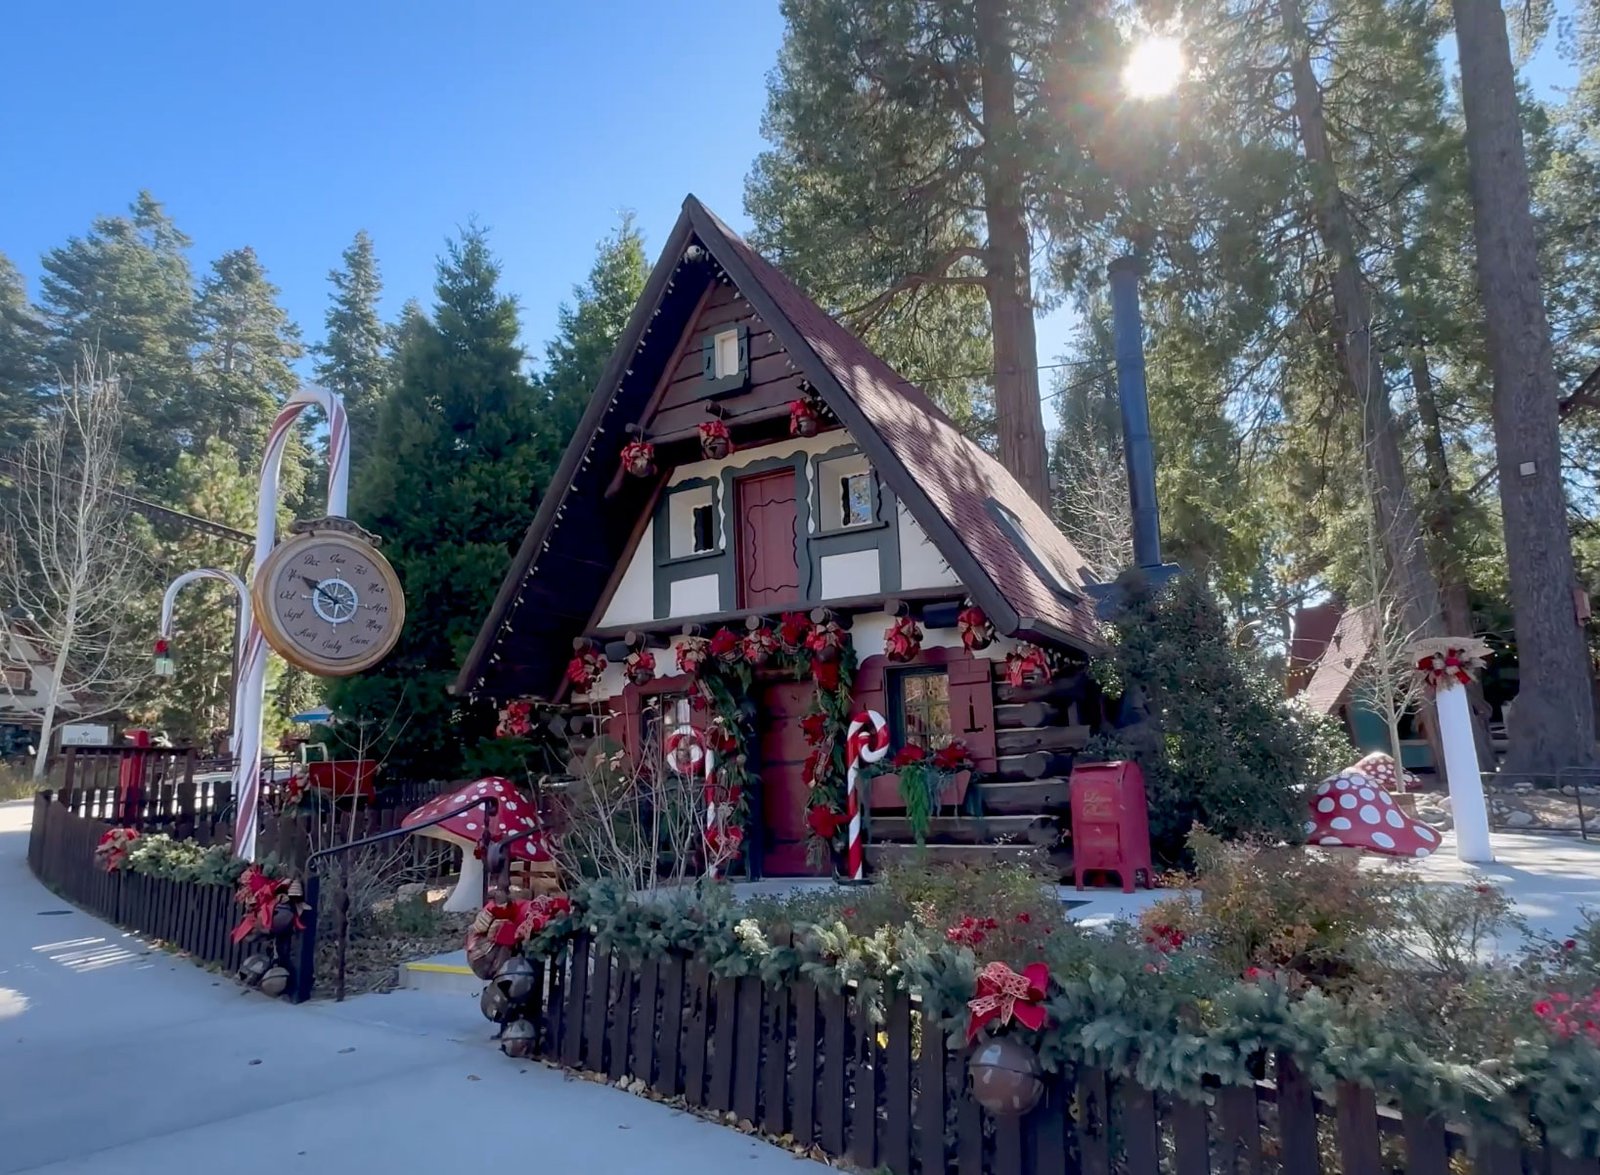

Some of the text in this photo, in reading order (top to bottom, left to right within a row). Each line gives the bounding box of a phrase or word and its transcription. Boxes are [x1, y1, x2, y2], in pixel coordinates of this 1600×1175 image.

[304, 555, 320, 567] Dec
[330, 554, 346, 564] Jan
[368, 583, 384, 594] Mar
[280, 590, 296, 600] Oct
[284, 609, 304, 621] Sept
[368, 604, 388, 615] Apr
[366, 619, 383, 632] May
[295, 628, 317, 640] Aug
[350, 635, 370, 645] June
[322, 639, 343, 653] July
